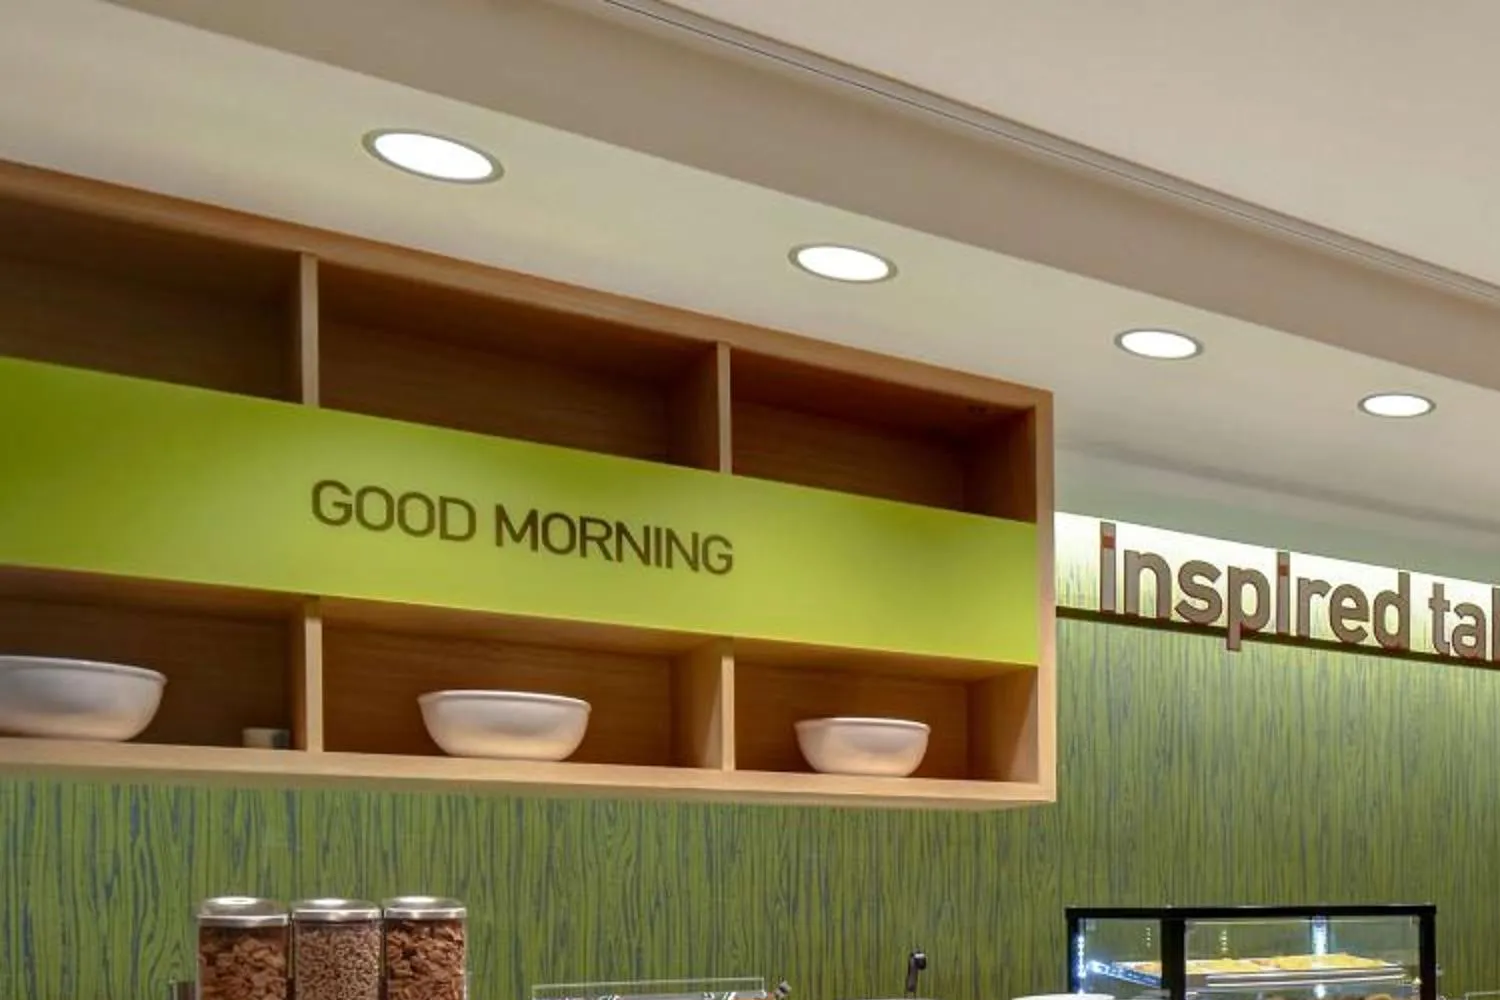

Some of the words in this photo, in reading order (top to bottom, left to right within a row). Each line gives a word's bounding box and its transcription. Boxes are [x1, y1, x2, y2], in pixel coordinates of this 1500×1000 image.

[311, 480, 477, 542] GOOD
[495, 504, 734, 575] MORNING
[1100, 521, 1411, 651] inspired
